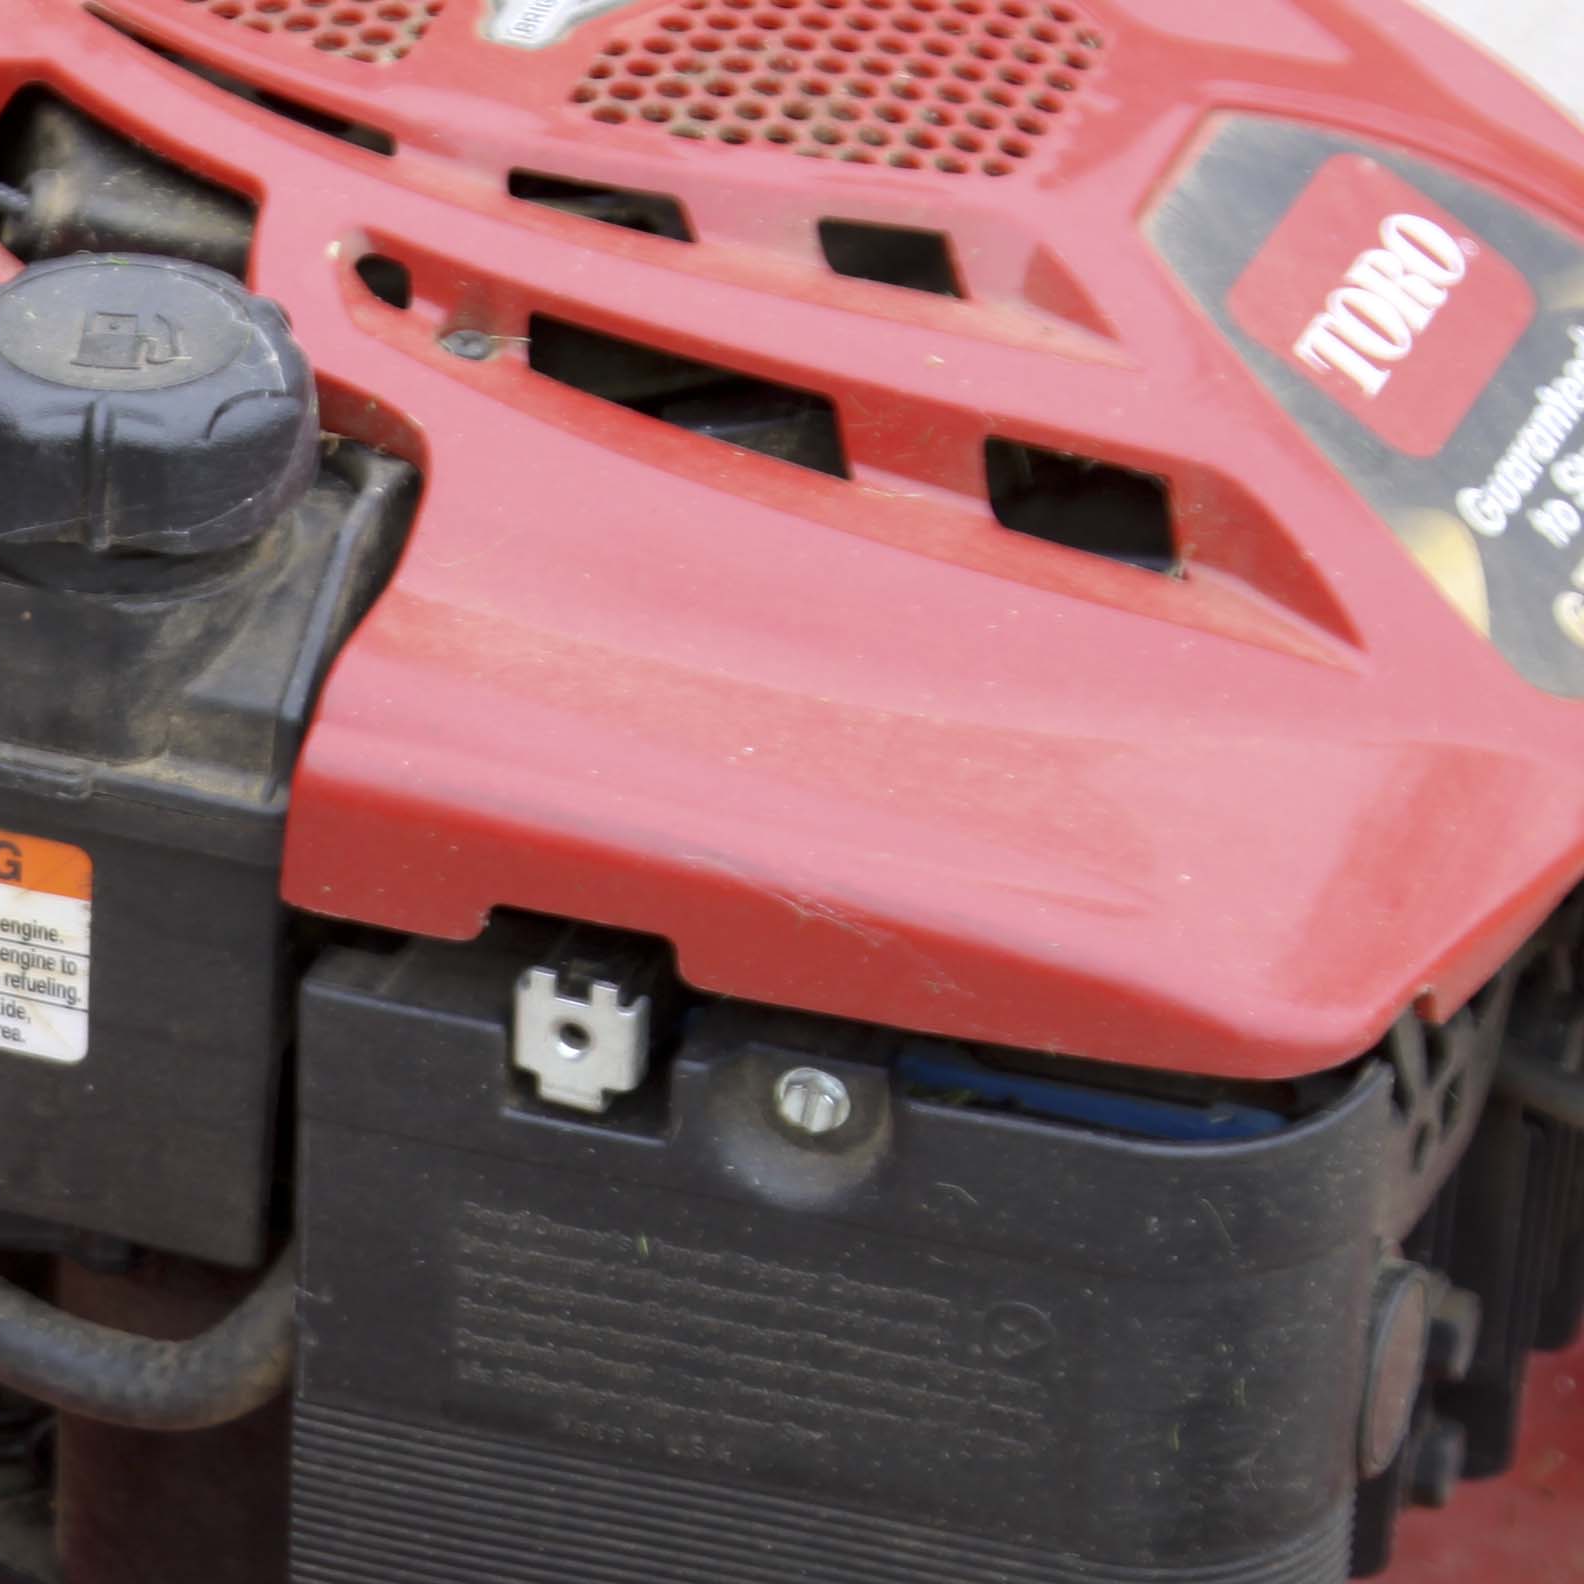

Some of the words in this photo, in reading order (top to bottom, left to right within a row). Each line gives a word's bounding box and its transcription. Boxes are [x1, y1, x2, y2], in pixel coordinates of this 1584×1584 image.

[1294, 213, 1466, 398] TORO
[0, 916, 64, 945] engine.
[0, 947, 56, 972] engine
[60, 956, 78, 976] to
[4, 971, 81, 1006] refueling.
